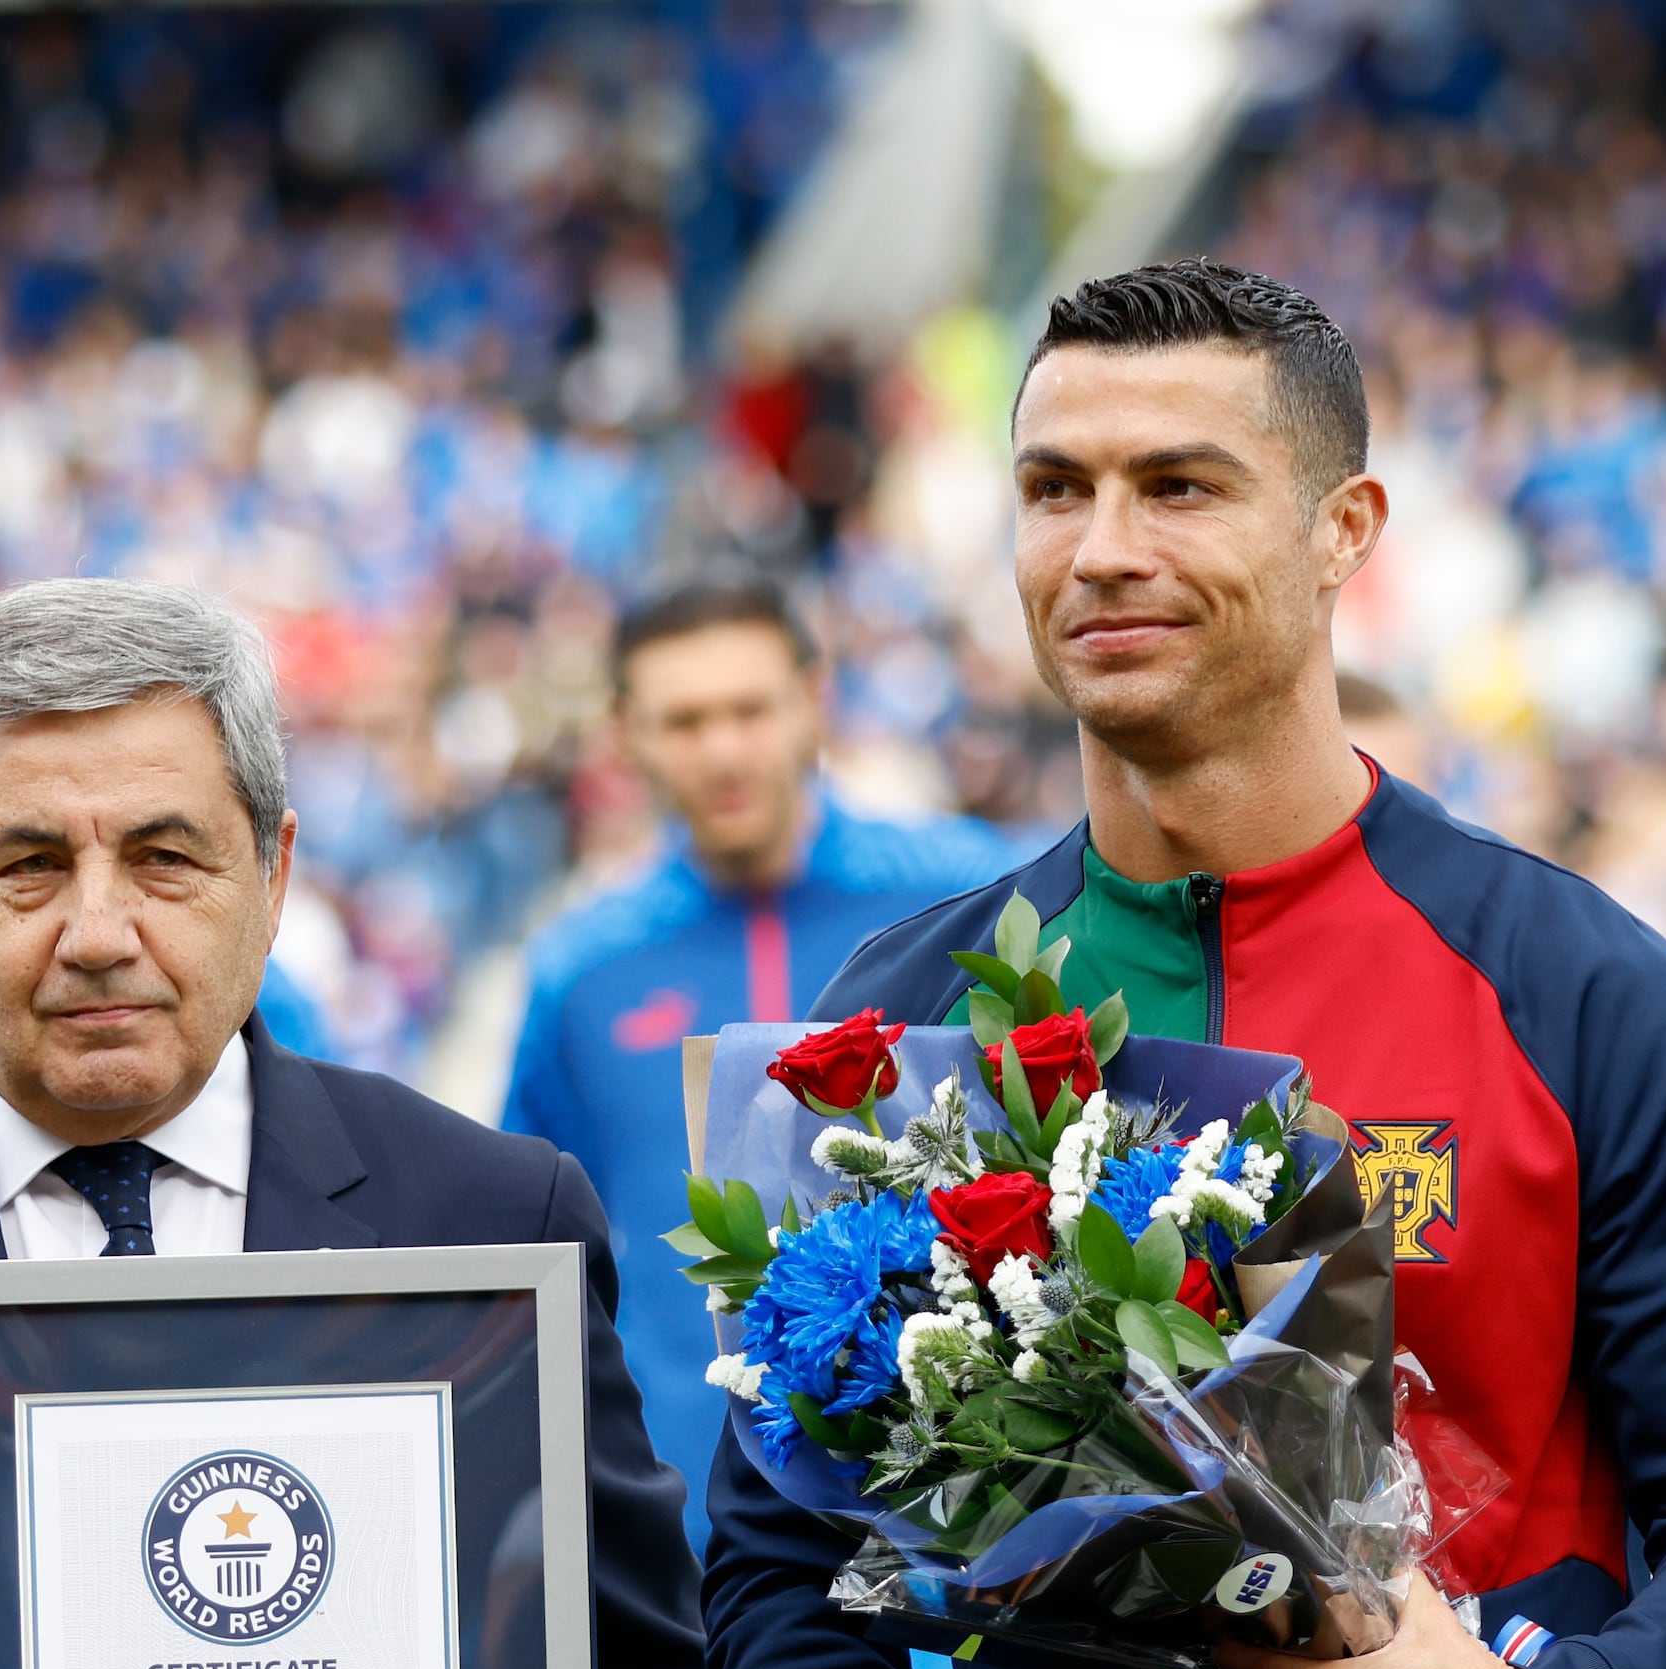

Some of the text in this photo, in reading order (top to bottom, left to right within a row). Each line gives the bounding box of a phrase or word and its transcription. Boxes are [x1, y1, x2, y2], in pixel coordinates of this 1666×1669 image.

[168, 1462, 307, 1514] GUINNESS
[153, 1533, 323, 1635] WORLD RECORDS
